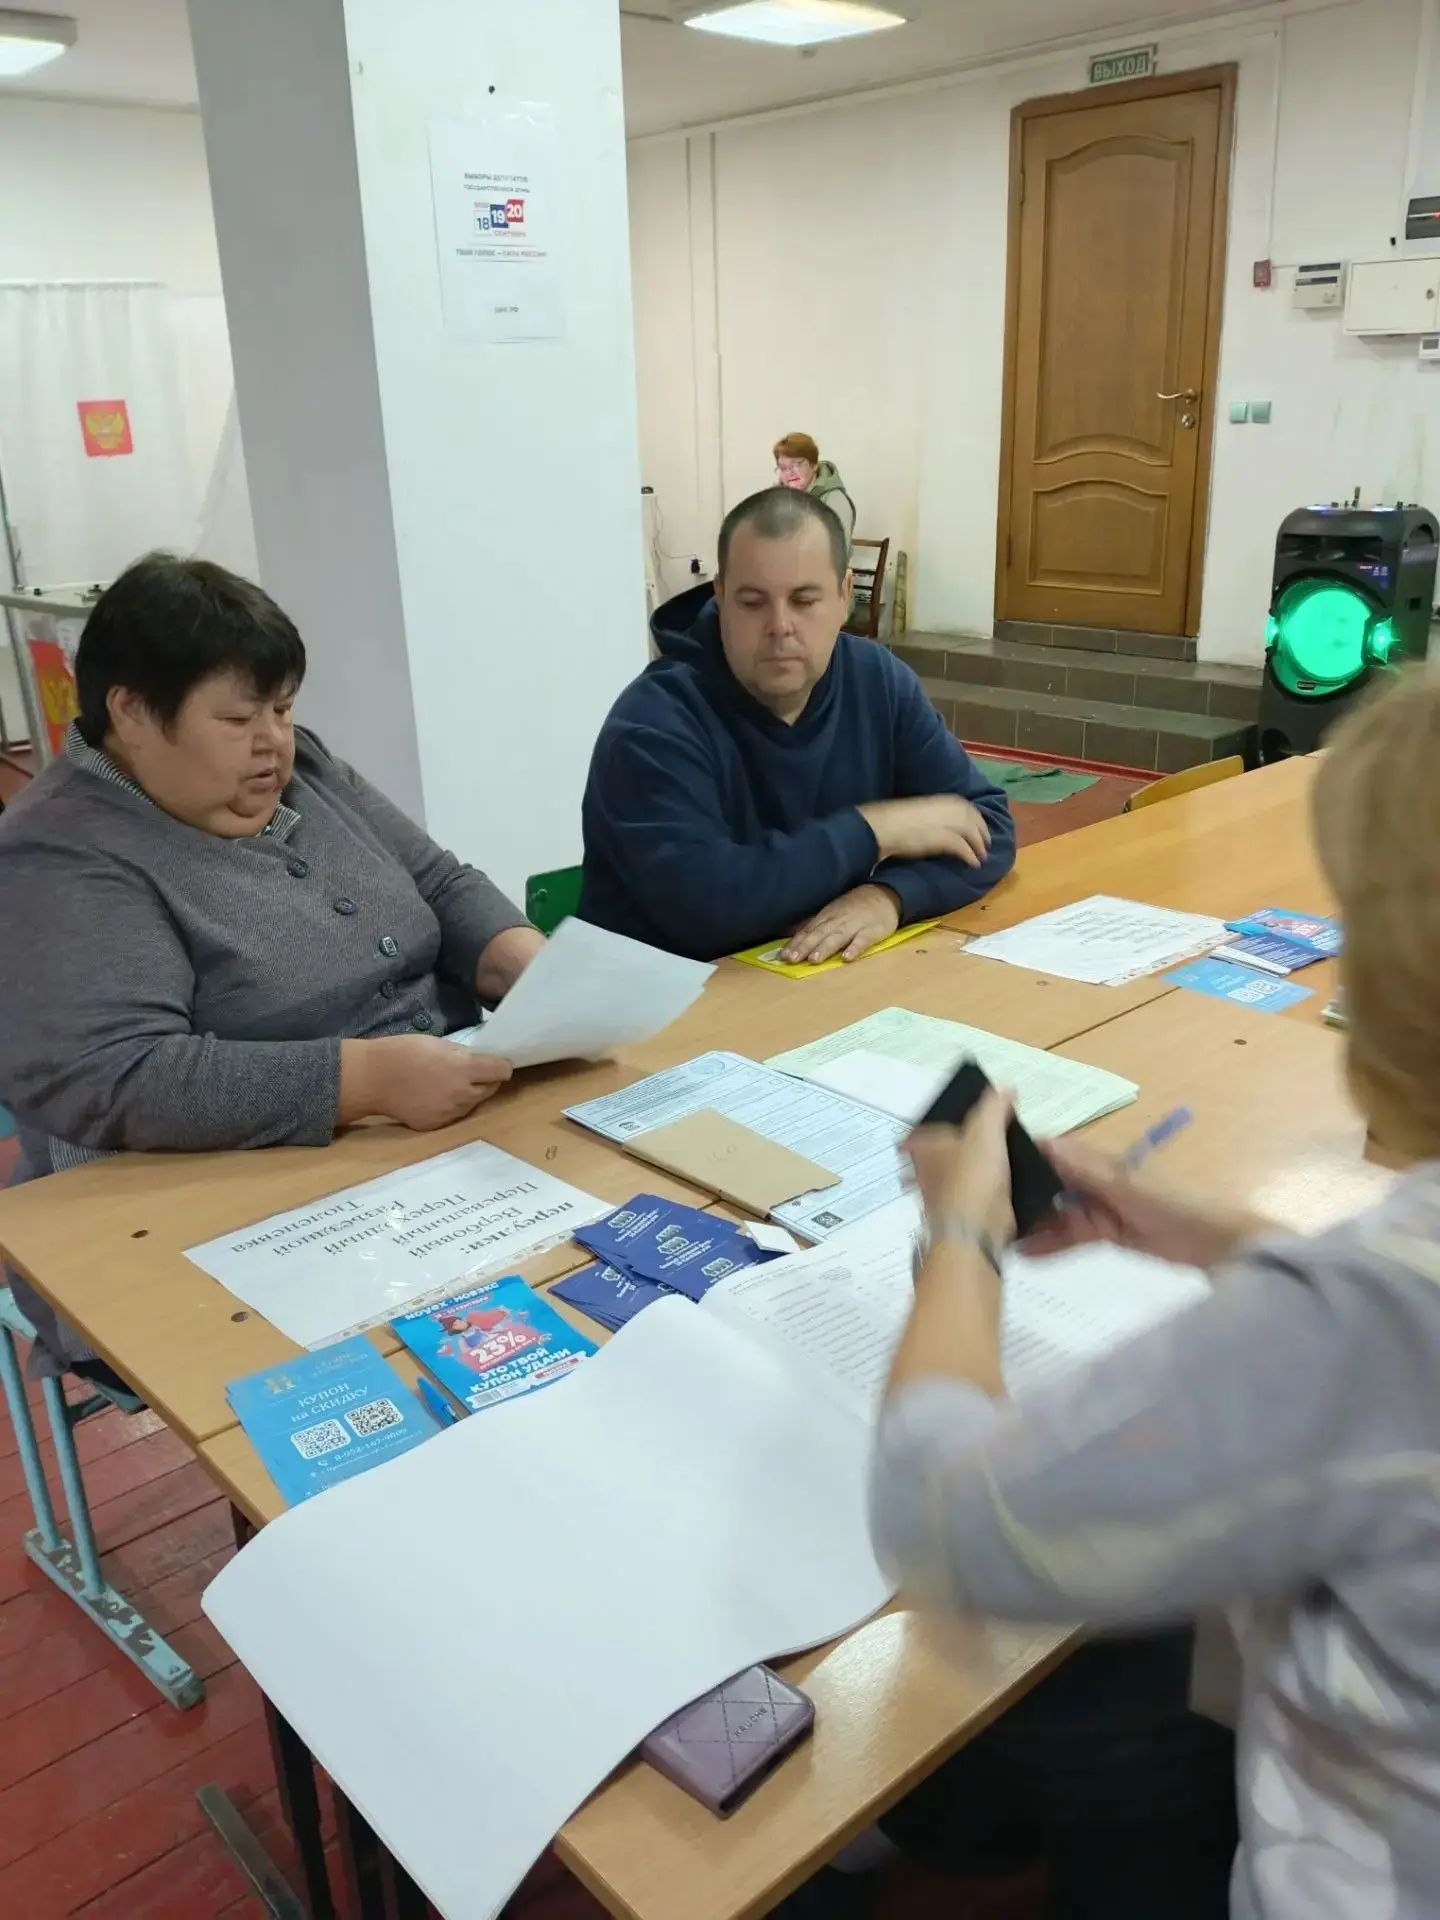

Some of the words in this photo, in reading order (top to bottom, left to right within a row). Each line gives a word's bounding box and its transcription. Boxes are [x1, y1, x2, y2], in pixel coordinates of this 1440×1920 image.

[1094, 56, 1146, 81] ВЫХОД
[477, 217, 490, 230] 18
[491, 209, 506, 224] 19
[506, 204, 522, 219] 20
[232, 1200, 366, 1253] Тюленевка
[392, 1182, 539, 1246] Перевальный
[460, 1202, 575, 1255] переулки:
[408, 1207, 524, 1259] Вербовый
[470, 1331, 527, 1364] 23%
[479, 1364, 508, 1381] ЭТО
[508, 1346, 550, 1371] ТВОЙ
[469, 1369, 523, 1394] КУПОН
[520, 1347, 573, 1379] УДАЧИ
[297, 1381, 351, 1408] КУПОН
[310, 1386, 369, 1415] СКИДКУ
